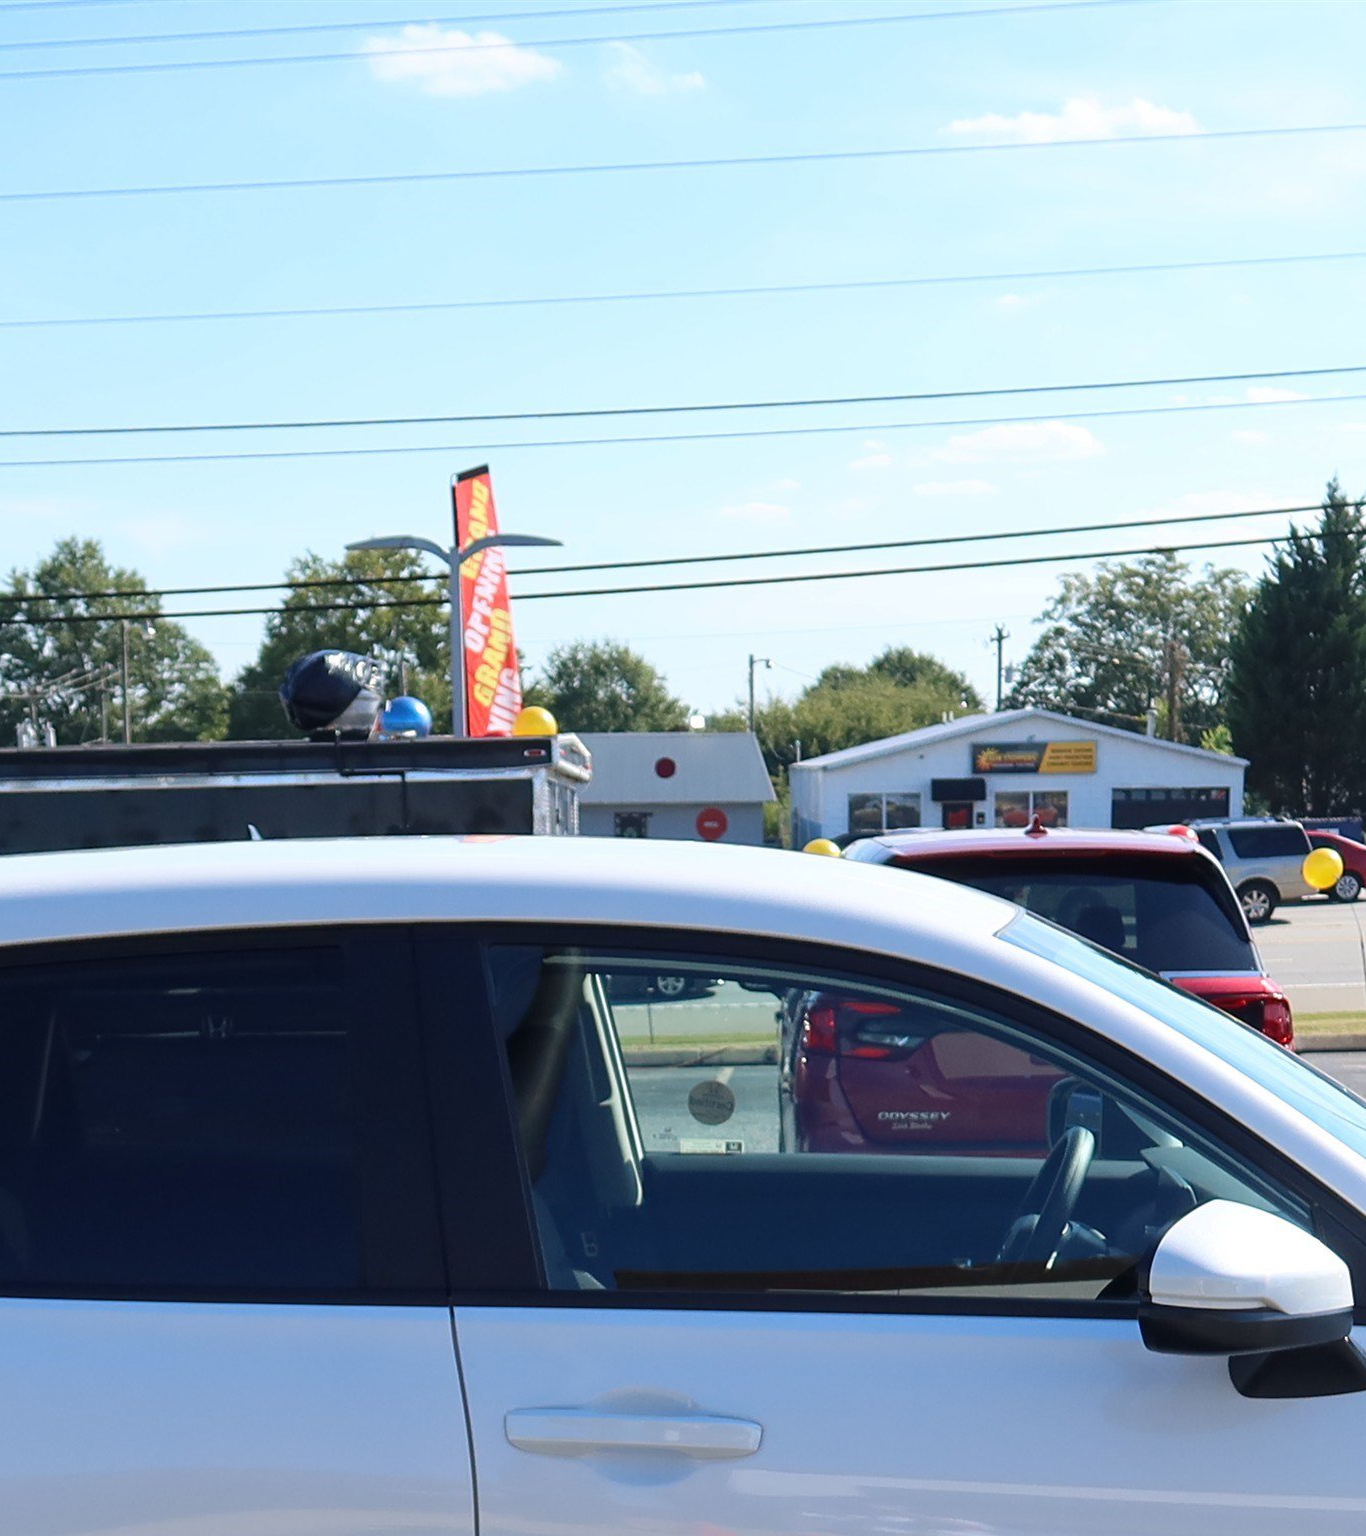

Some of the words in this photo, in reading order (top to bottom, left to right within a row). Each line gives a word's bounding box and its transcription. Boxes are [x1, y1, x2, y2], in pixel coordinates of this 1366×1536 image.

[464, 528, 504, 653] OPENIN
[473, 608, 512, 707] GRAND
[877, 1111, 952, 1121] ODYSSEY
